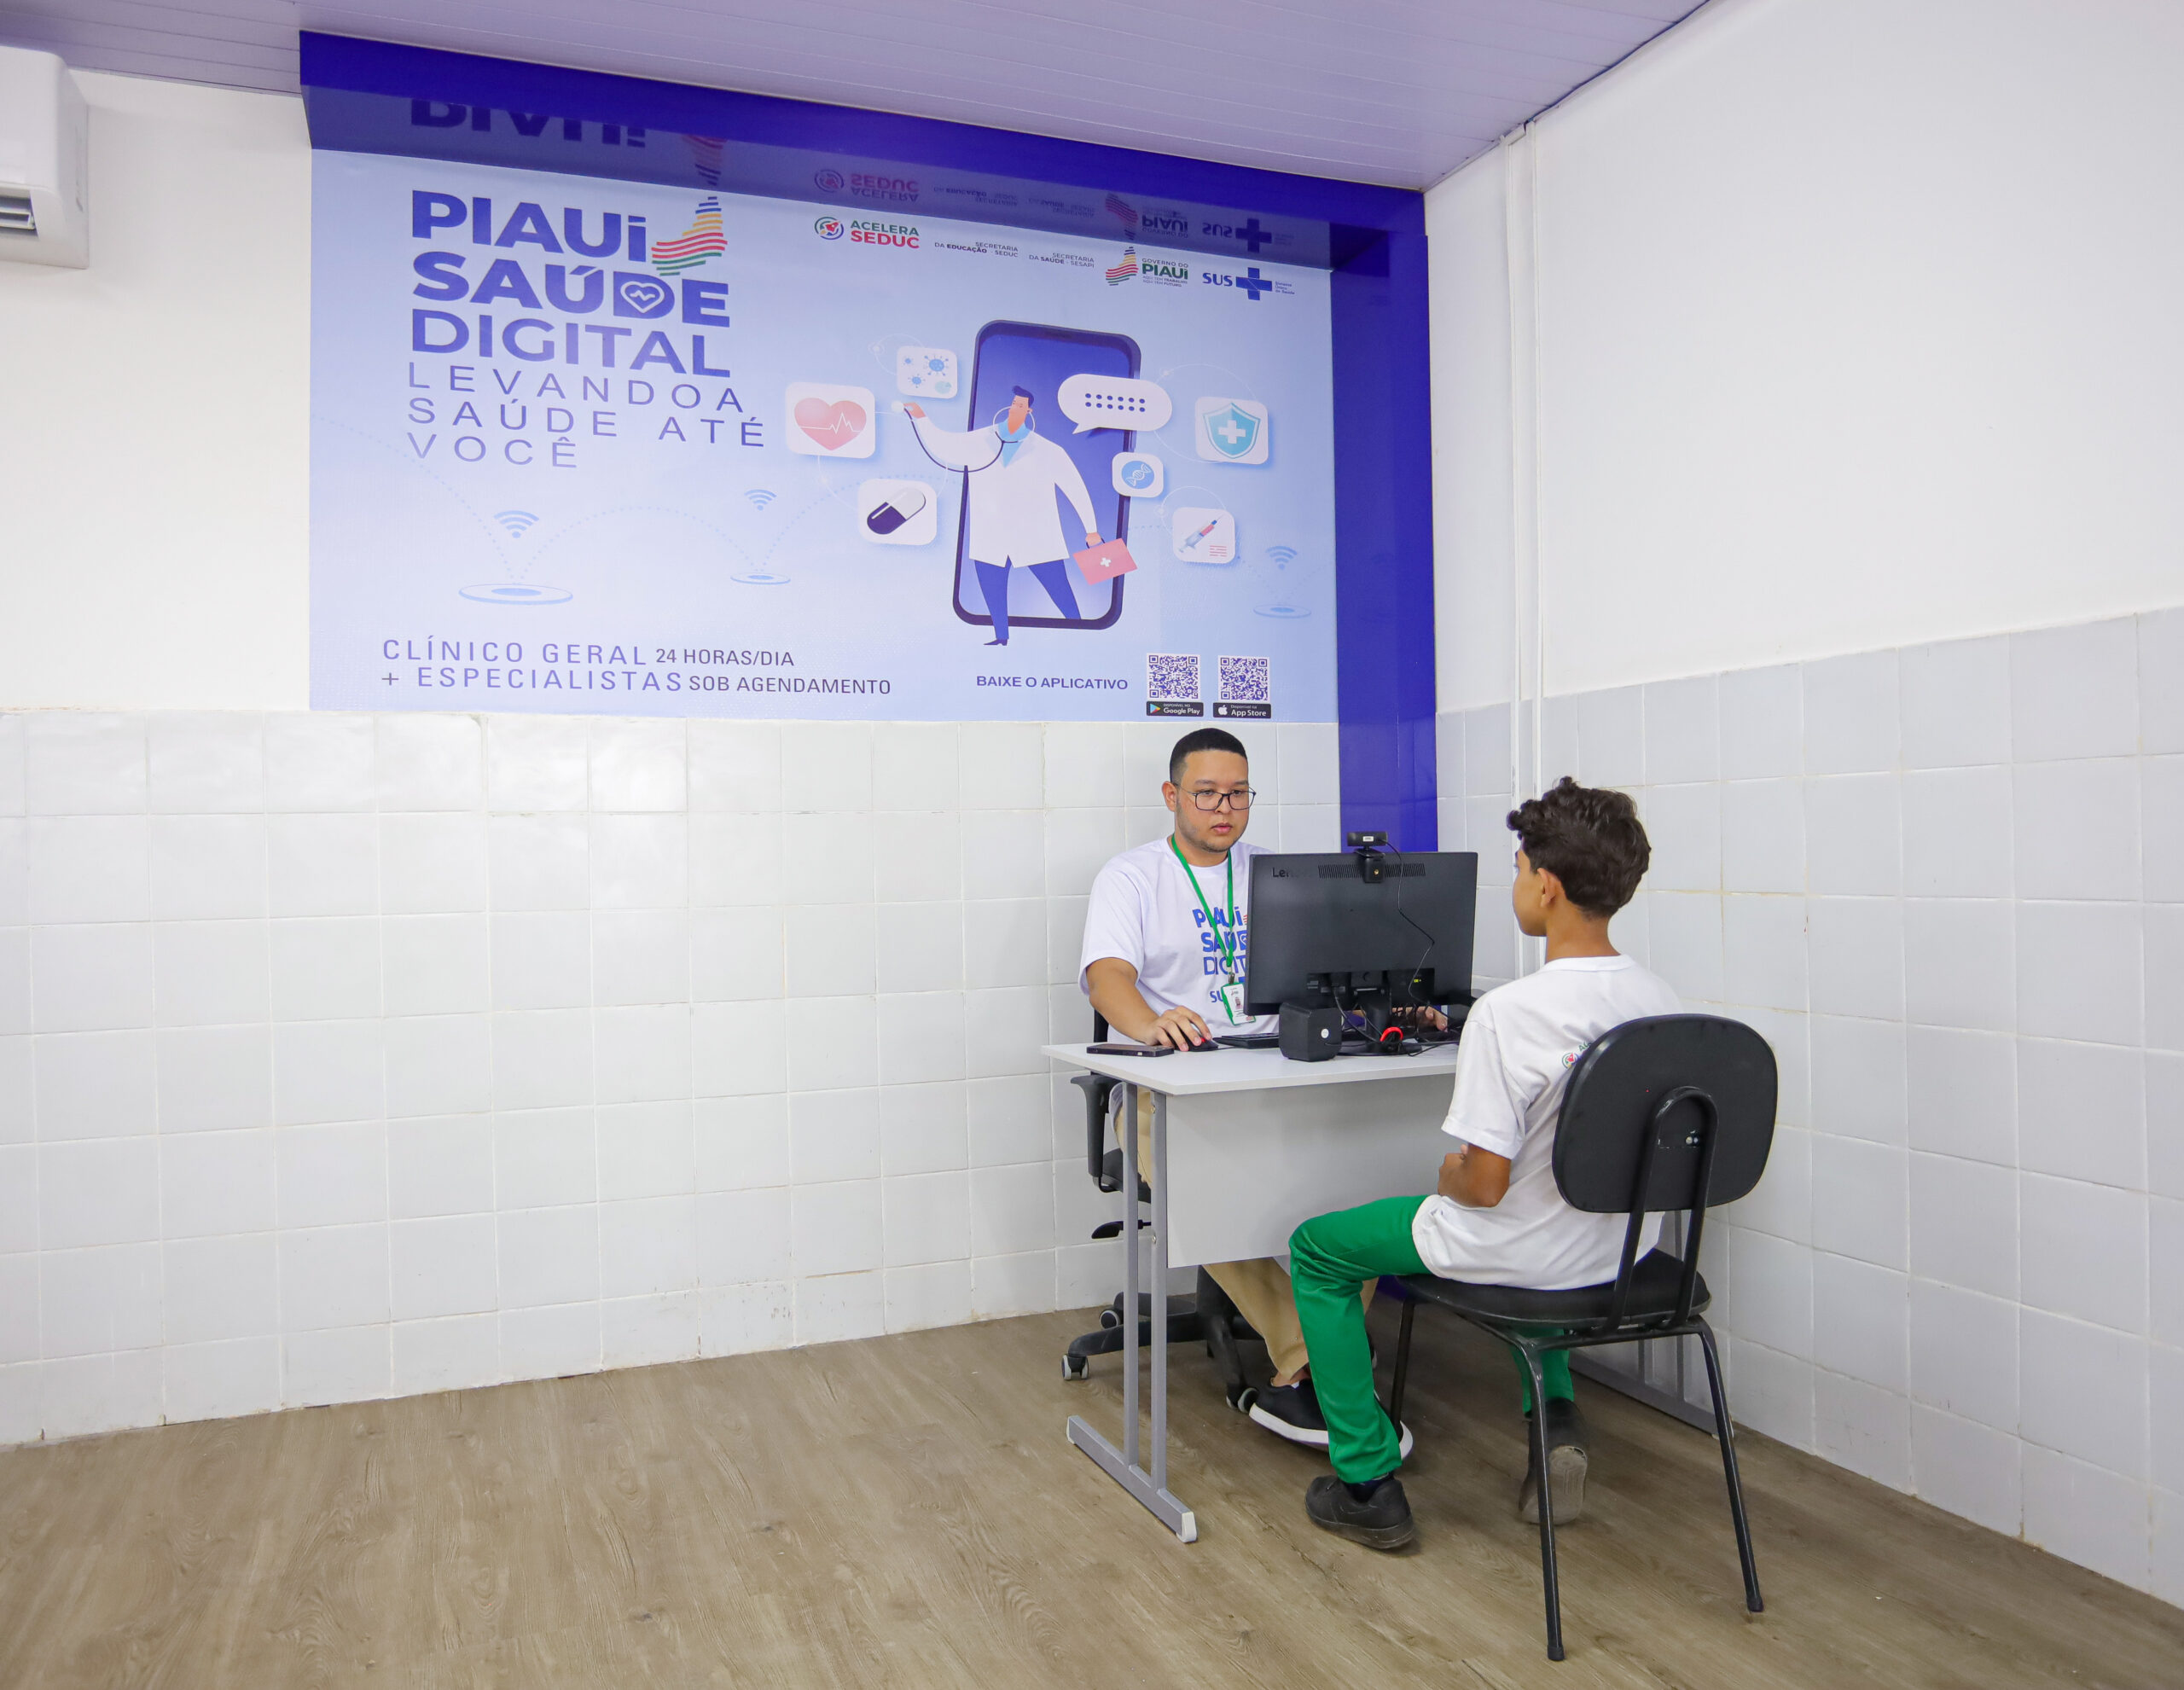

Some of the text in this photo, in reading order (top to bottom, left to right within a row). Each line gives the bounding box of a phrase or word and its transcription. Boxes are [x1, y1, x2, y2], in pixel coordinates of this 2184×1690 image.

[850, 219, 920, 236] ACELERA
[850, 229, 920, 249] SEDUC
[975, 241, 1019, 253] SECRETARIA
[946, 243, 988, 254] EDUCAÇÃO
[995, 249, 1019, 258] SEDUC
[1052, 252, 1095, 264] SECRETARIA
[1141, 258, 1176, 267] GOVERNO
[412, 250, 730, 328] SAÚDE
[1202, 272, 1234, 287] SUS
[411, 308, 731, 378] DIGITAL
[407, 397, 765, 448] SAÚDE ATÉ
[406, 432, 578, 468] VOCÊ
[382, 636, 648, 666] CLÍNICO GERAL
[654, 648, 794, 667] 24 HORAS/DIA
[416, 666, 683, 693] ESPECIALISTAS
[688, 675, 892, 695] SOB AGENDAMENTO
[976, 676, 1128, 690] BAIXE O APLICATIVO
[1163, 706, 1187, 715] Google
